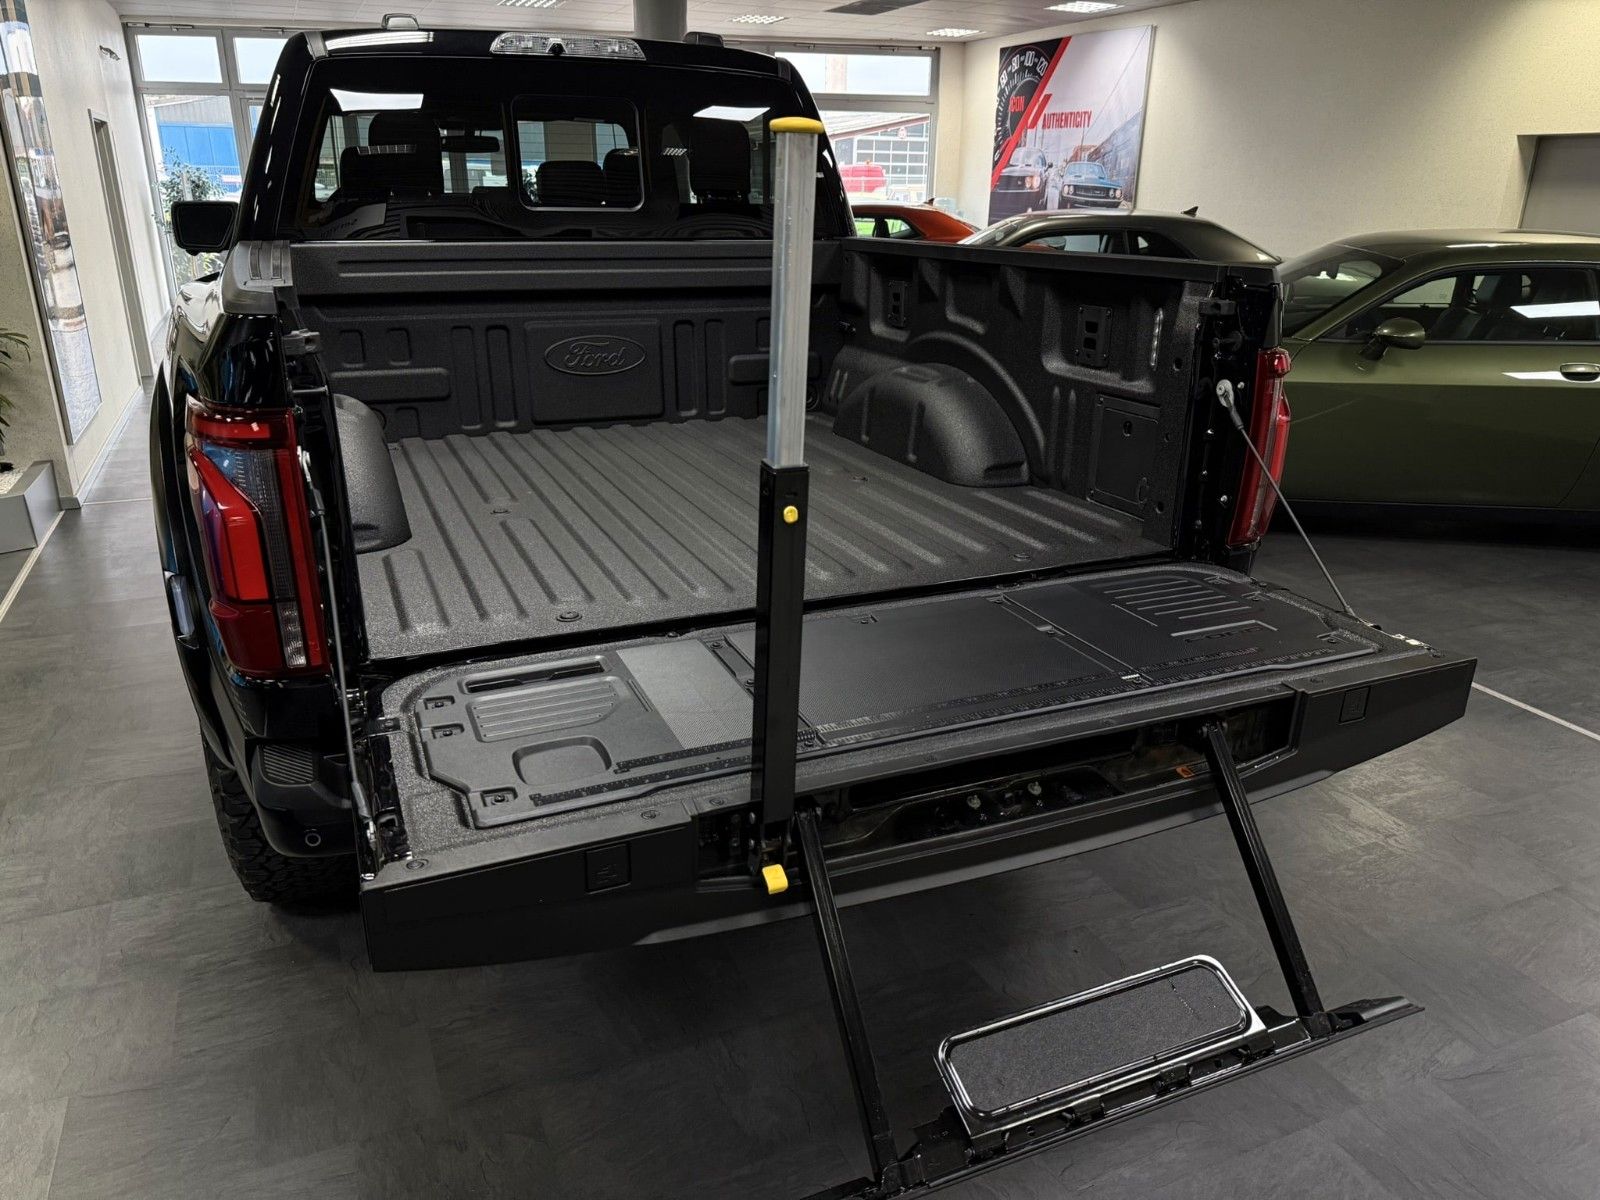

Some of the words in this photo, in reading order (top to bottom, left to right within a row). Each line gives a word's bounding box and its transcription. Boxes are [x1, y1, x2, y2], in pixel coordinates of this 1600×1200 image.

[1024, 51, 1035, 66] 100
[1042, 111, 1092, 129] AUTHENTICITY
[564, 341, 626, 367] Ford
